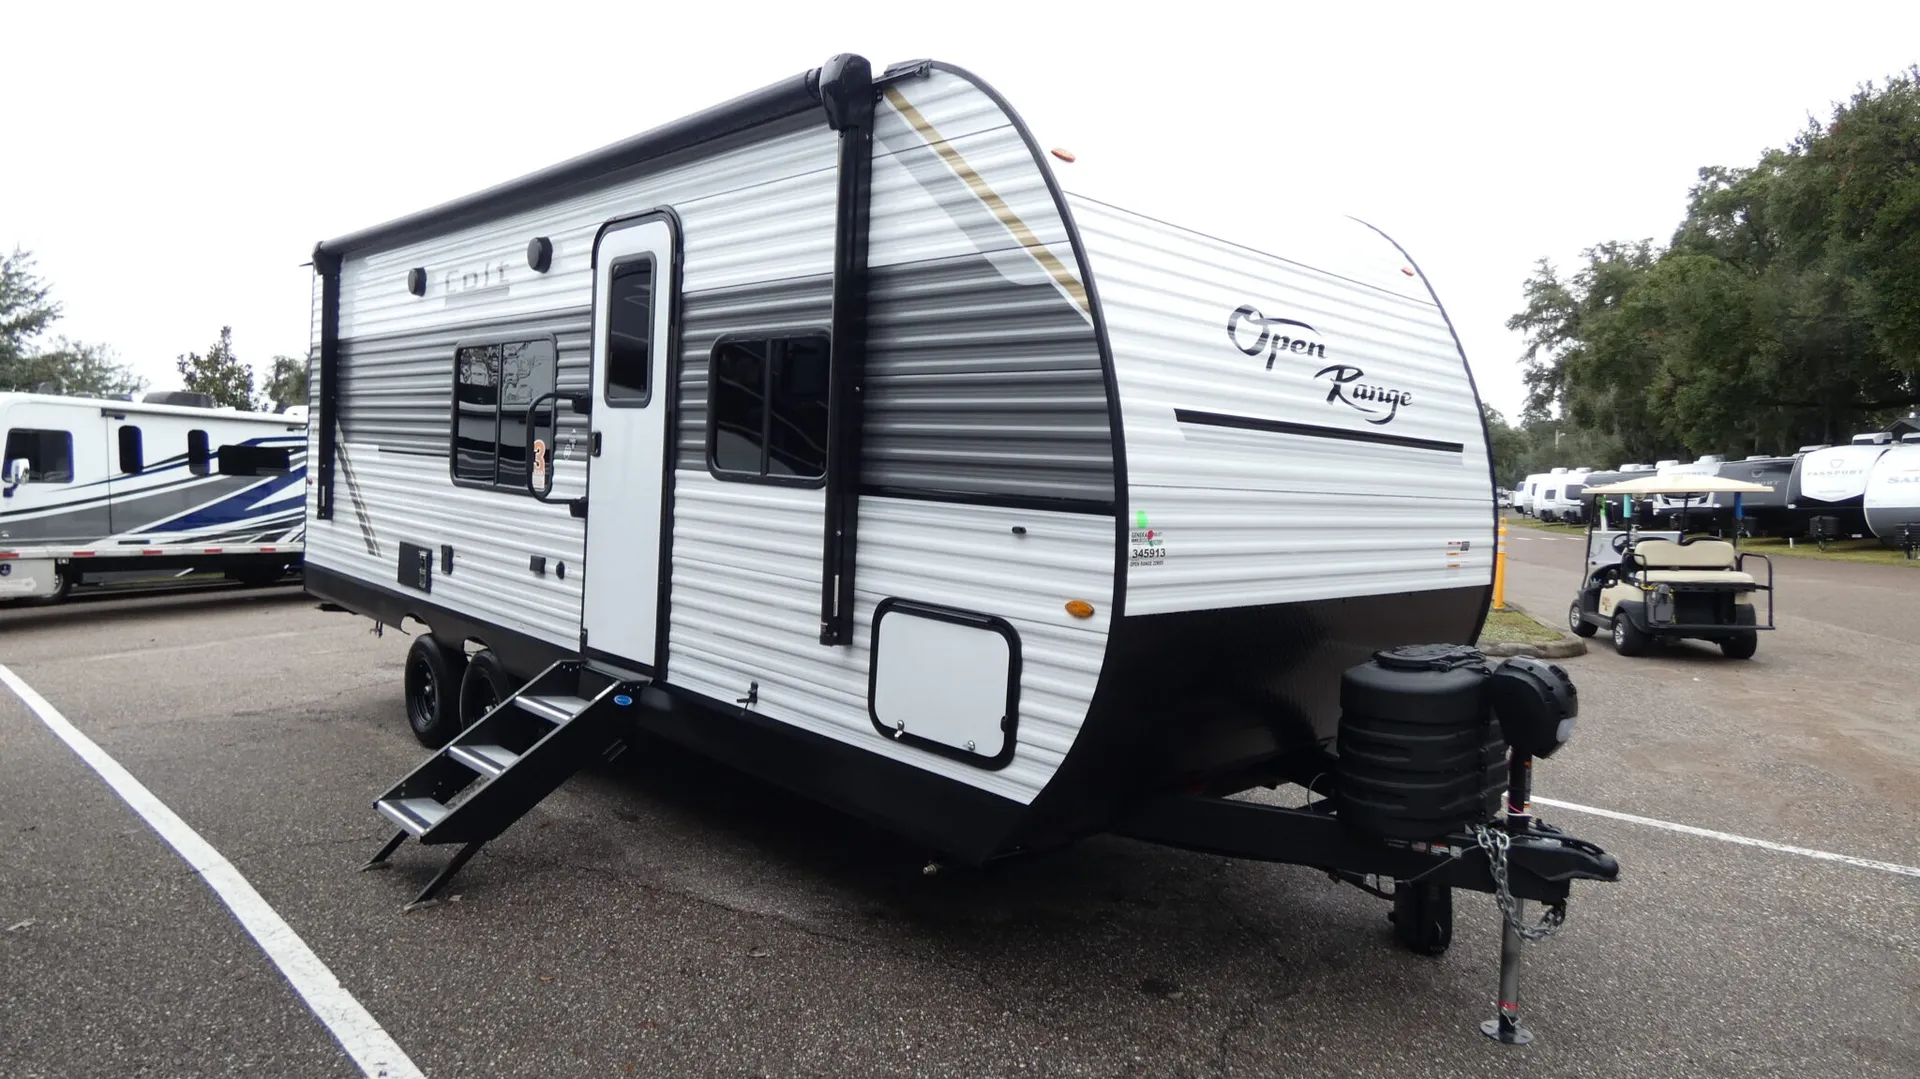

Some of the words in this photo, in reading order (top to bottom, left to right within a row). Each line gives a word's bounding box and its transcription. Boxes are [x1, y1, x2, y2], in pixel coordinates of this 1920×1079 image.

[1227, 304, 1327, 372] Open
[1313, 364, 1414, 425] Range
[1132, 548, 1166, 558] 345913
